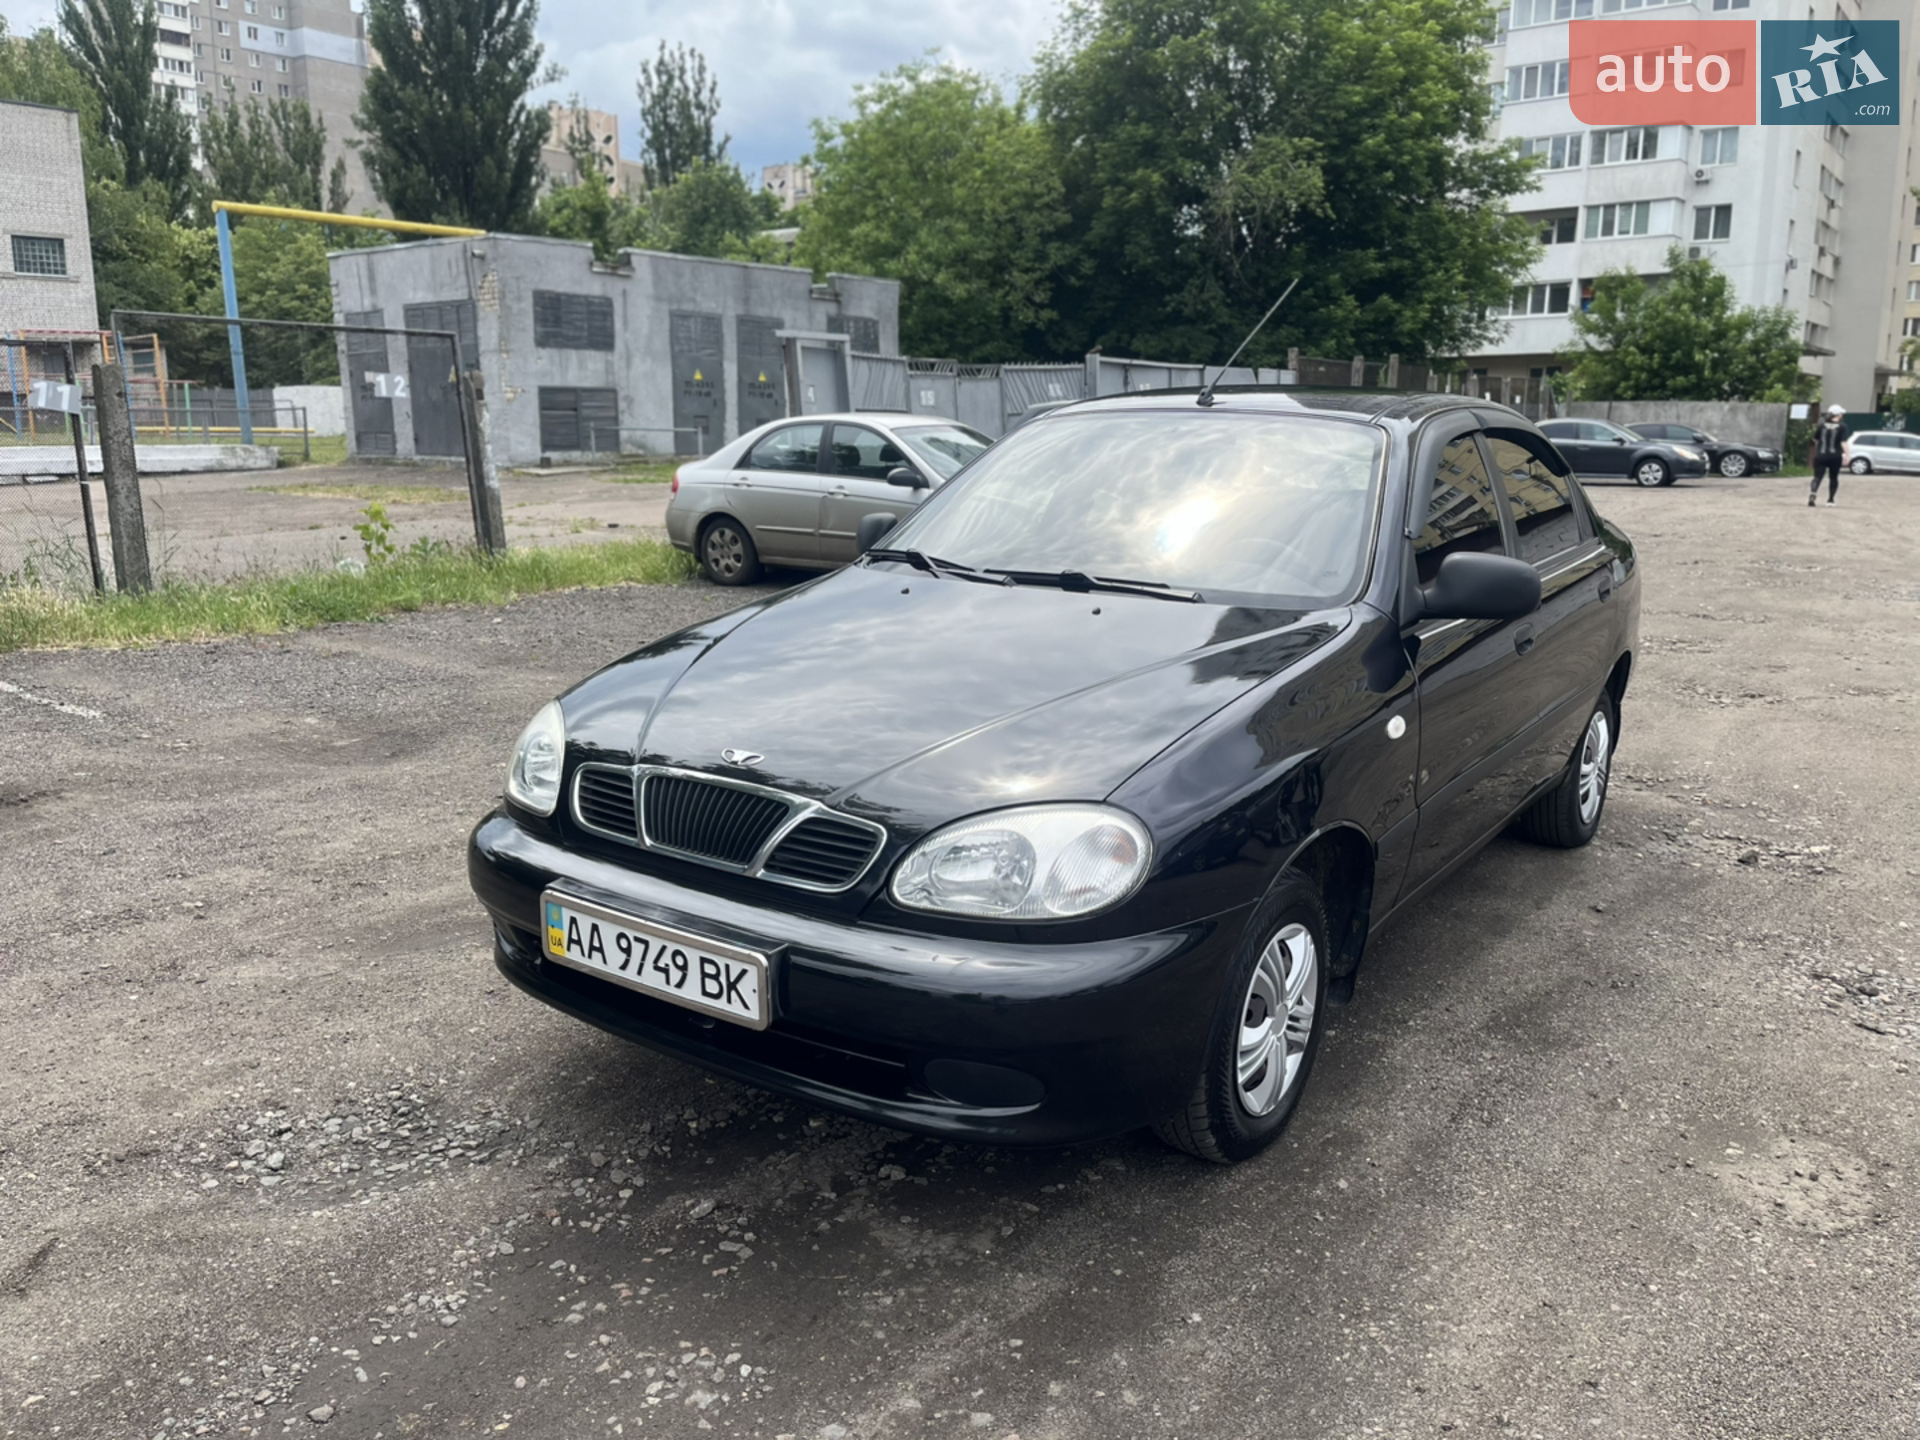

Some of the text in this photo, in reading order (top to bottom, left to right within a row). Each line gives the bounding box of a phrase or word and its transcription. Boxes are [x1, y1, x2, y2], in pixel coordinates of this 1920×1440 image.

[33, 381, 71, 410] 11
[375, 374, 407, 397] 12
[550, 935, 564, 949] UA
[566, 915, 752, 1012] AA 9749 BK
